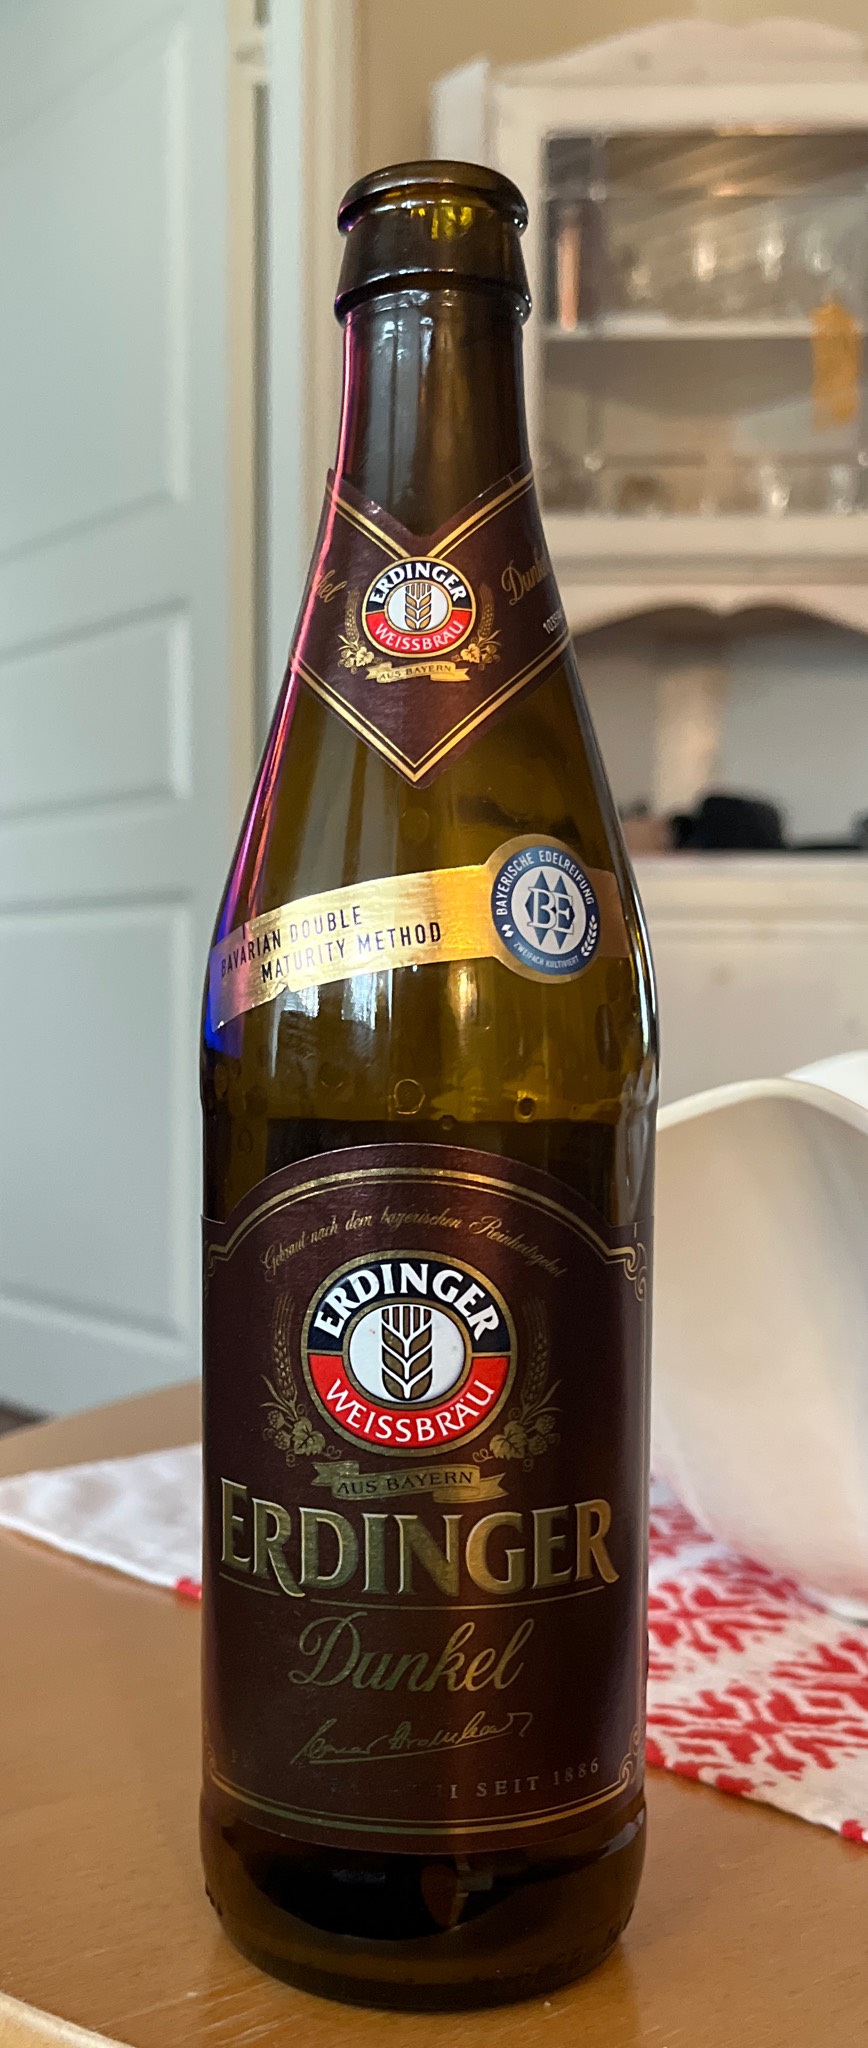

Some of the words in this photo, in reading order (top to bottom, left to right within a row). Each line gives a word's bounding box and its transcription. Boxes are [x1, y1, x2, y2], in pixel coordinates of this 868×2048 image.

[369, 562, 467, 605] ERDINGER
[380, 671, 401, 680] AUS
[405, 664, 452, 676] BAYERN
[496, 852, 534, 916] BAYERISCHE
[538, 850, 595, 905] EDELREIFUNG
[221, 928, 282, 977] BAVARIAN
[289, 905, 363, 943] DOUBLE
[261, 938, 346, 983] MATURITY
[357, 921, 442, 954] METHOD
[345, 1210, 373, 1231] dem
[380, 1205, 462, 1232] bayerischen
[313, 1262, 501, 1341] ERDINGER
[326, 1378, 496, 1443] WEISSBRÄU
[336, 1481, 378, 1495] AUS
[387, 1470, 474, 1492] BAYERN
[219, 1476, 620, 1598] ERDINGER
[287, 1611, 535, 1693] Dunkel
[476, 1776, 540, 1797] SEIT
[553, 1757, 600, 1786] 1886
